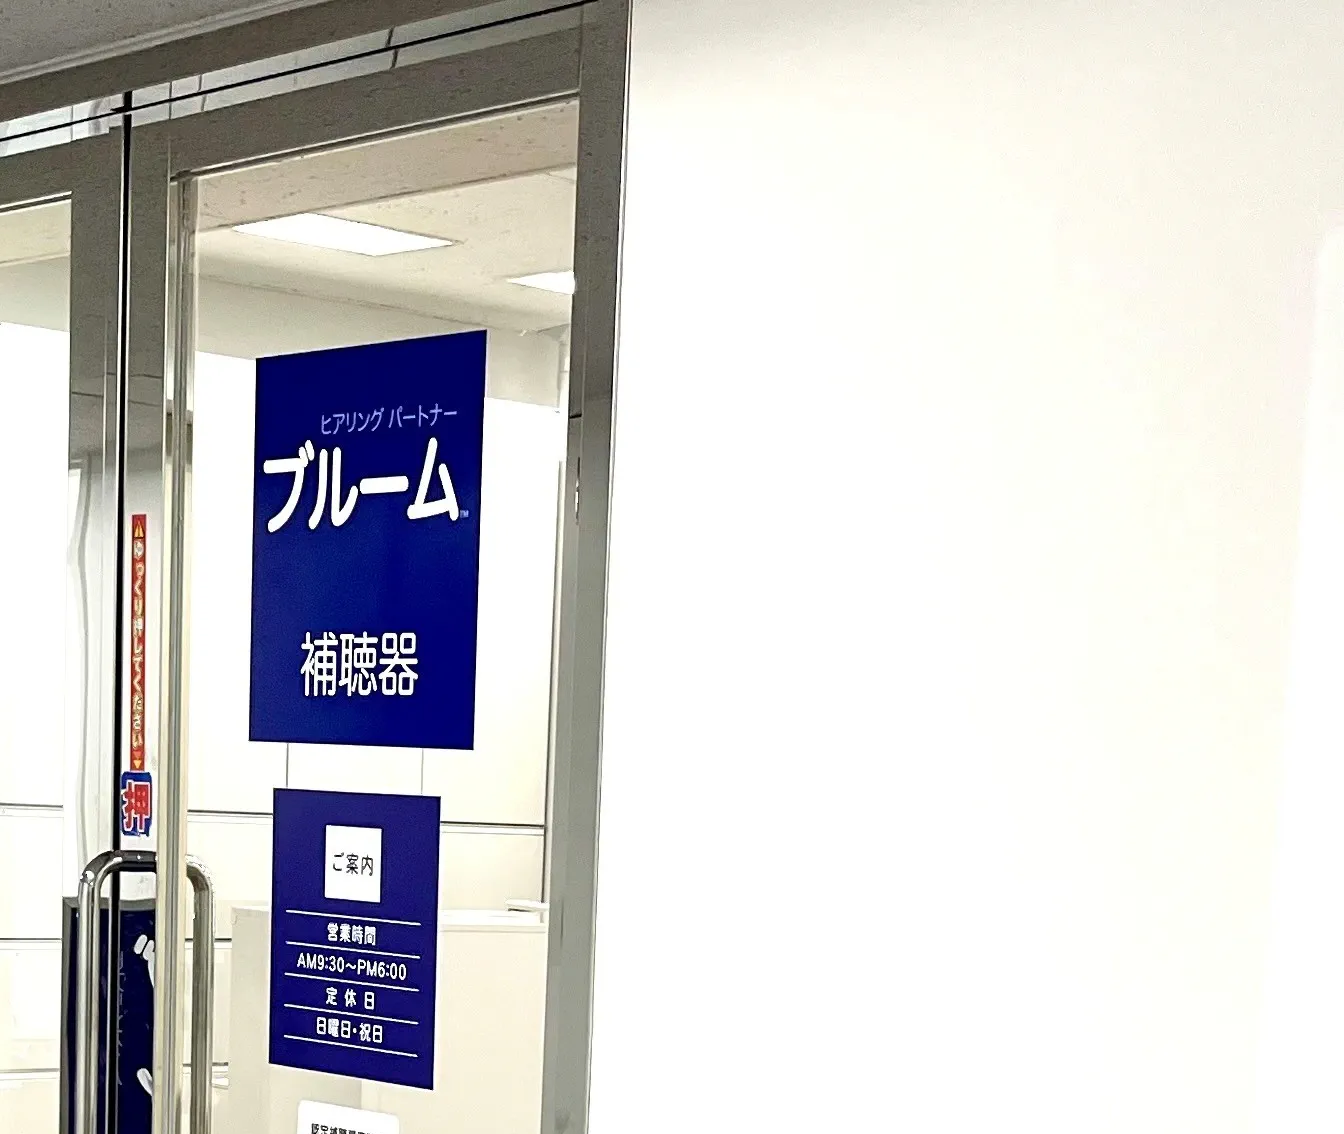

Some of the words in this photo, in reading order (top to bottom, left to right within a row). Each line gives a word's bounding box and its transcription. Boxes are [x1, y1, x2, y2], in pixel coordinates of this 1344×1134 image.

[321, 407, 385, 435] ヒアリング
[388, 403, 457, 429] パートナー
[263, 437, 459, 533] ブルーム
[300, 631, 418, 697] 補聴器
[122, 779, 151, 832] 押
[332, 852, 374, 877] ご案内
[327, 922, 376, 946] 営業時間
[316, 1016, 383, 1044] 日曜日・祝日
